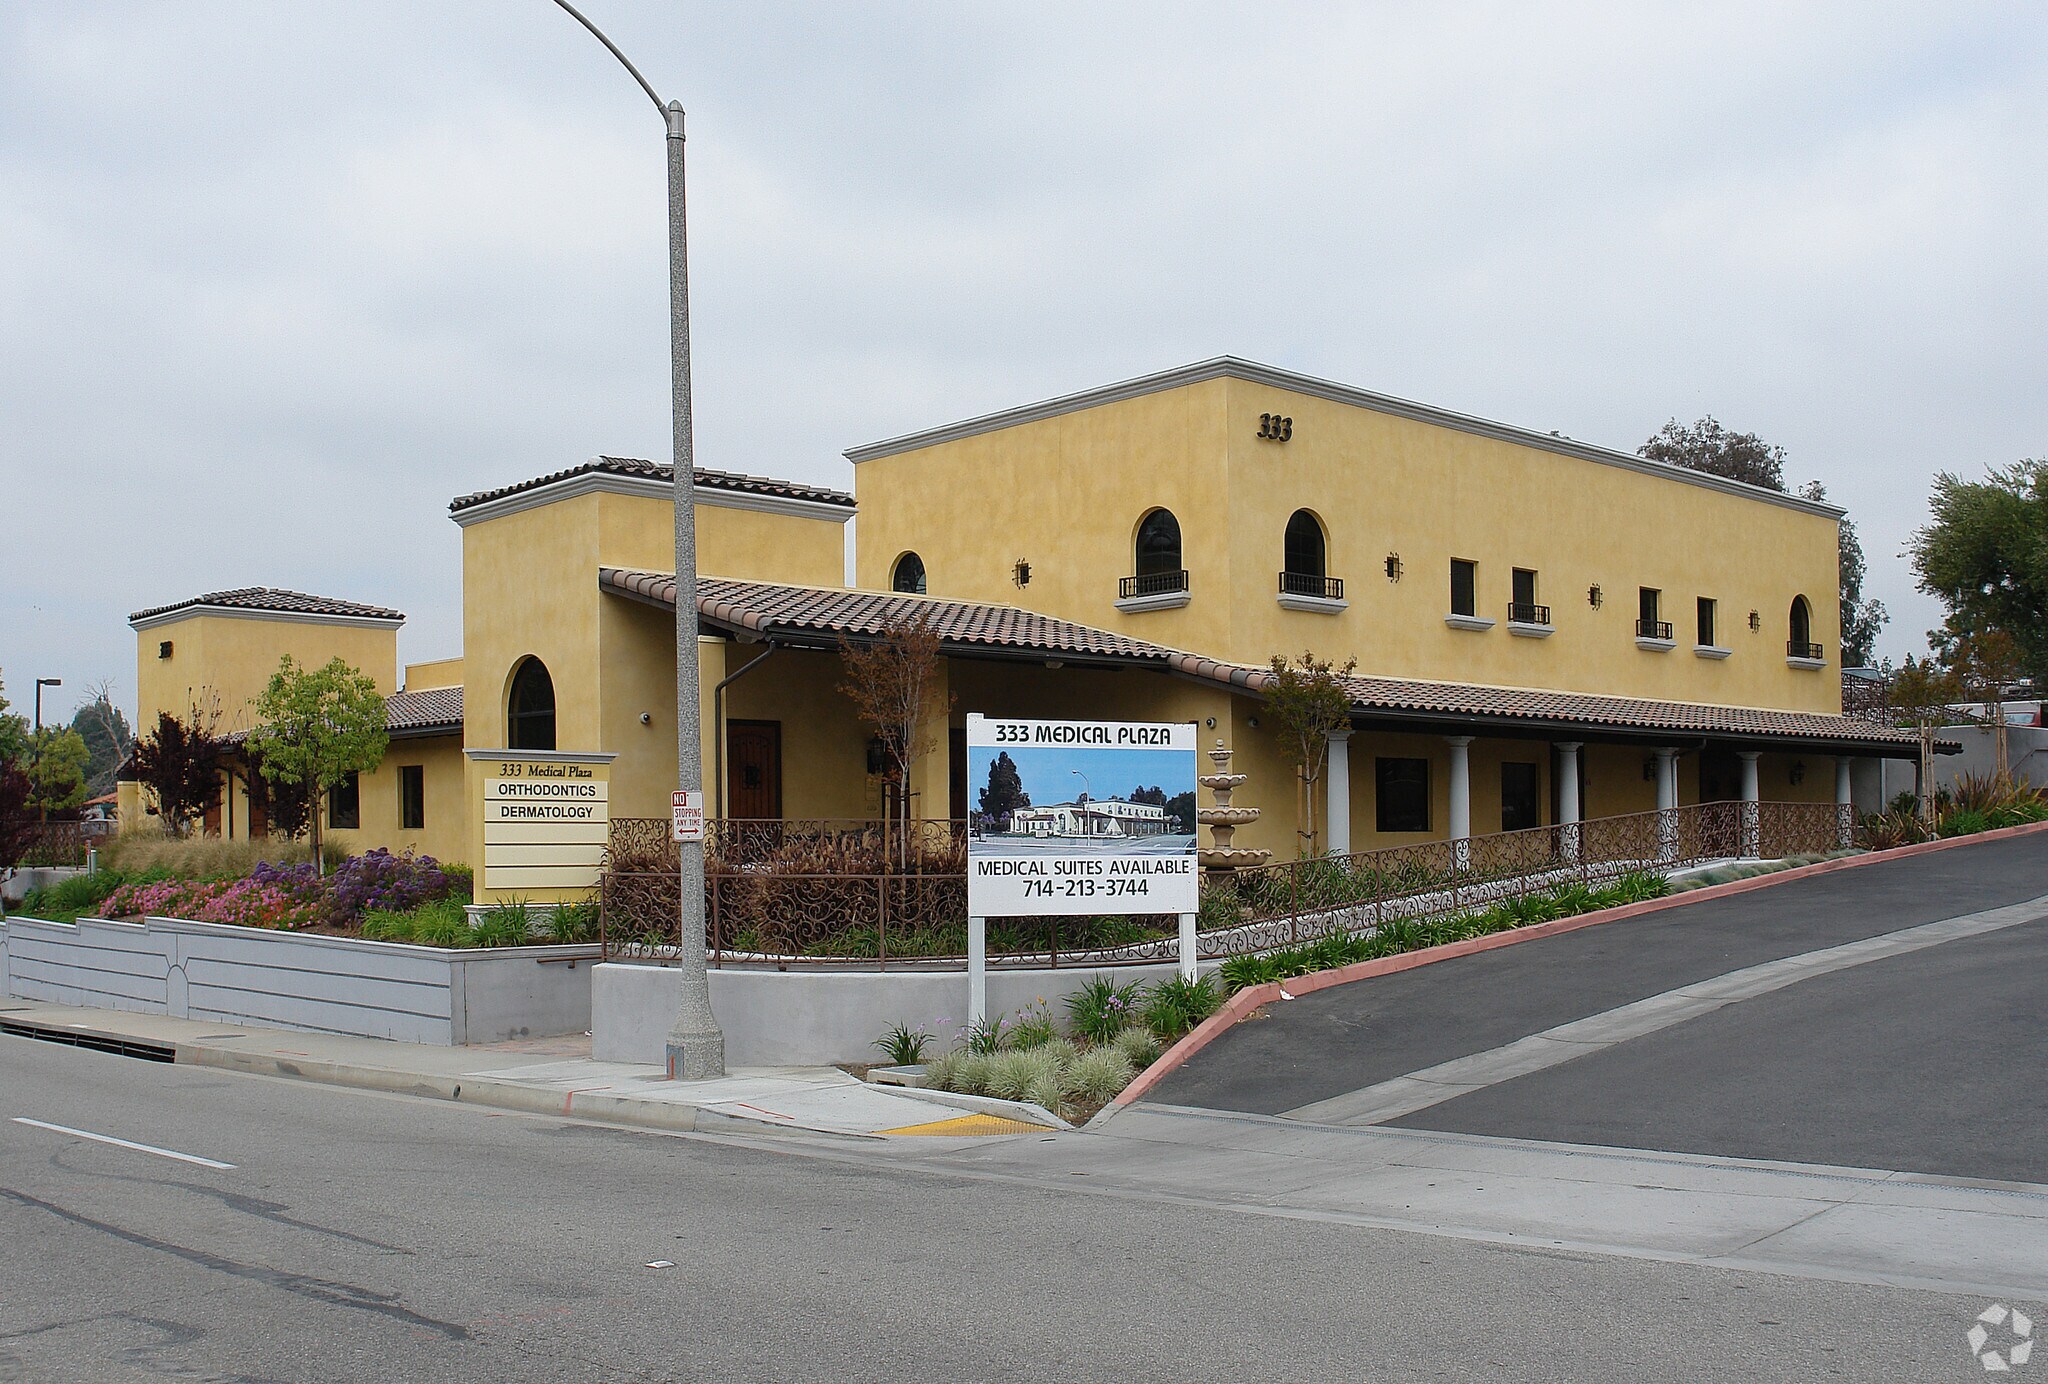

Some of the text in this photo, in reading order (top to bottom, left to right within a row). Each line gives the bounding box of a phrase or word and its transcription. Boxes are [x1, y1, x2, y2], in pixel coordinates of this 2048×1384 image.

[1256, 412, 1293, 442] 333
[996, 724, 1171, 745] 333 MEDICAL PLAZA
[499, 763, 592, 777] 333 Medical Plaza
[498, 783, 596, 797] ORTHODONTICS
[673, 793, 685, 805] NO
[501, 806, 593, 818] DERMATOLOGY
[674, 808, 701, 818] STOPPING
[676, 818, 701, 827] ANY TIME
[978, 859, 1190, 876] MEDICAL SUITES AVAILABLE
[1022, 878, 1149, 898] 714-213-3744
